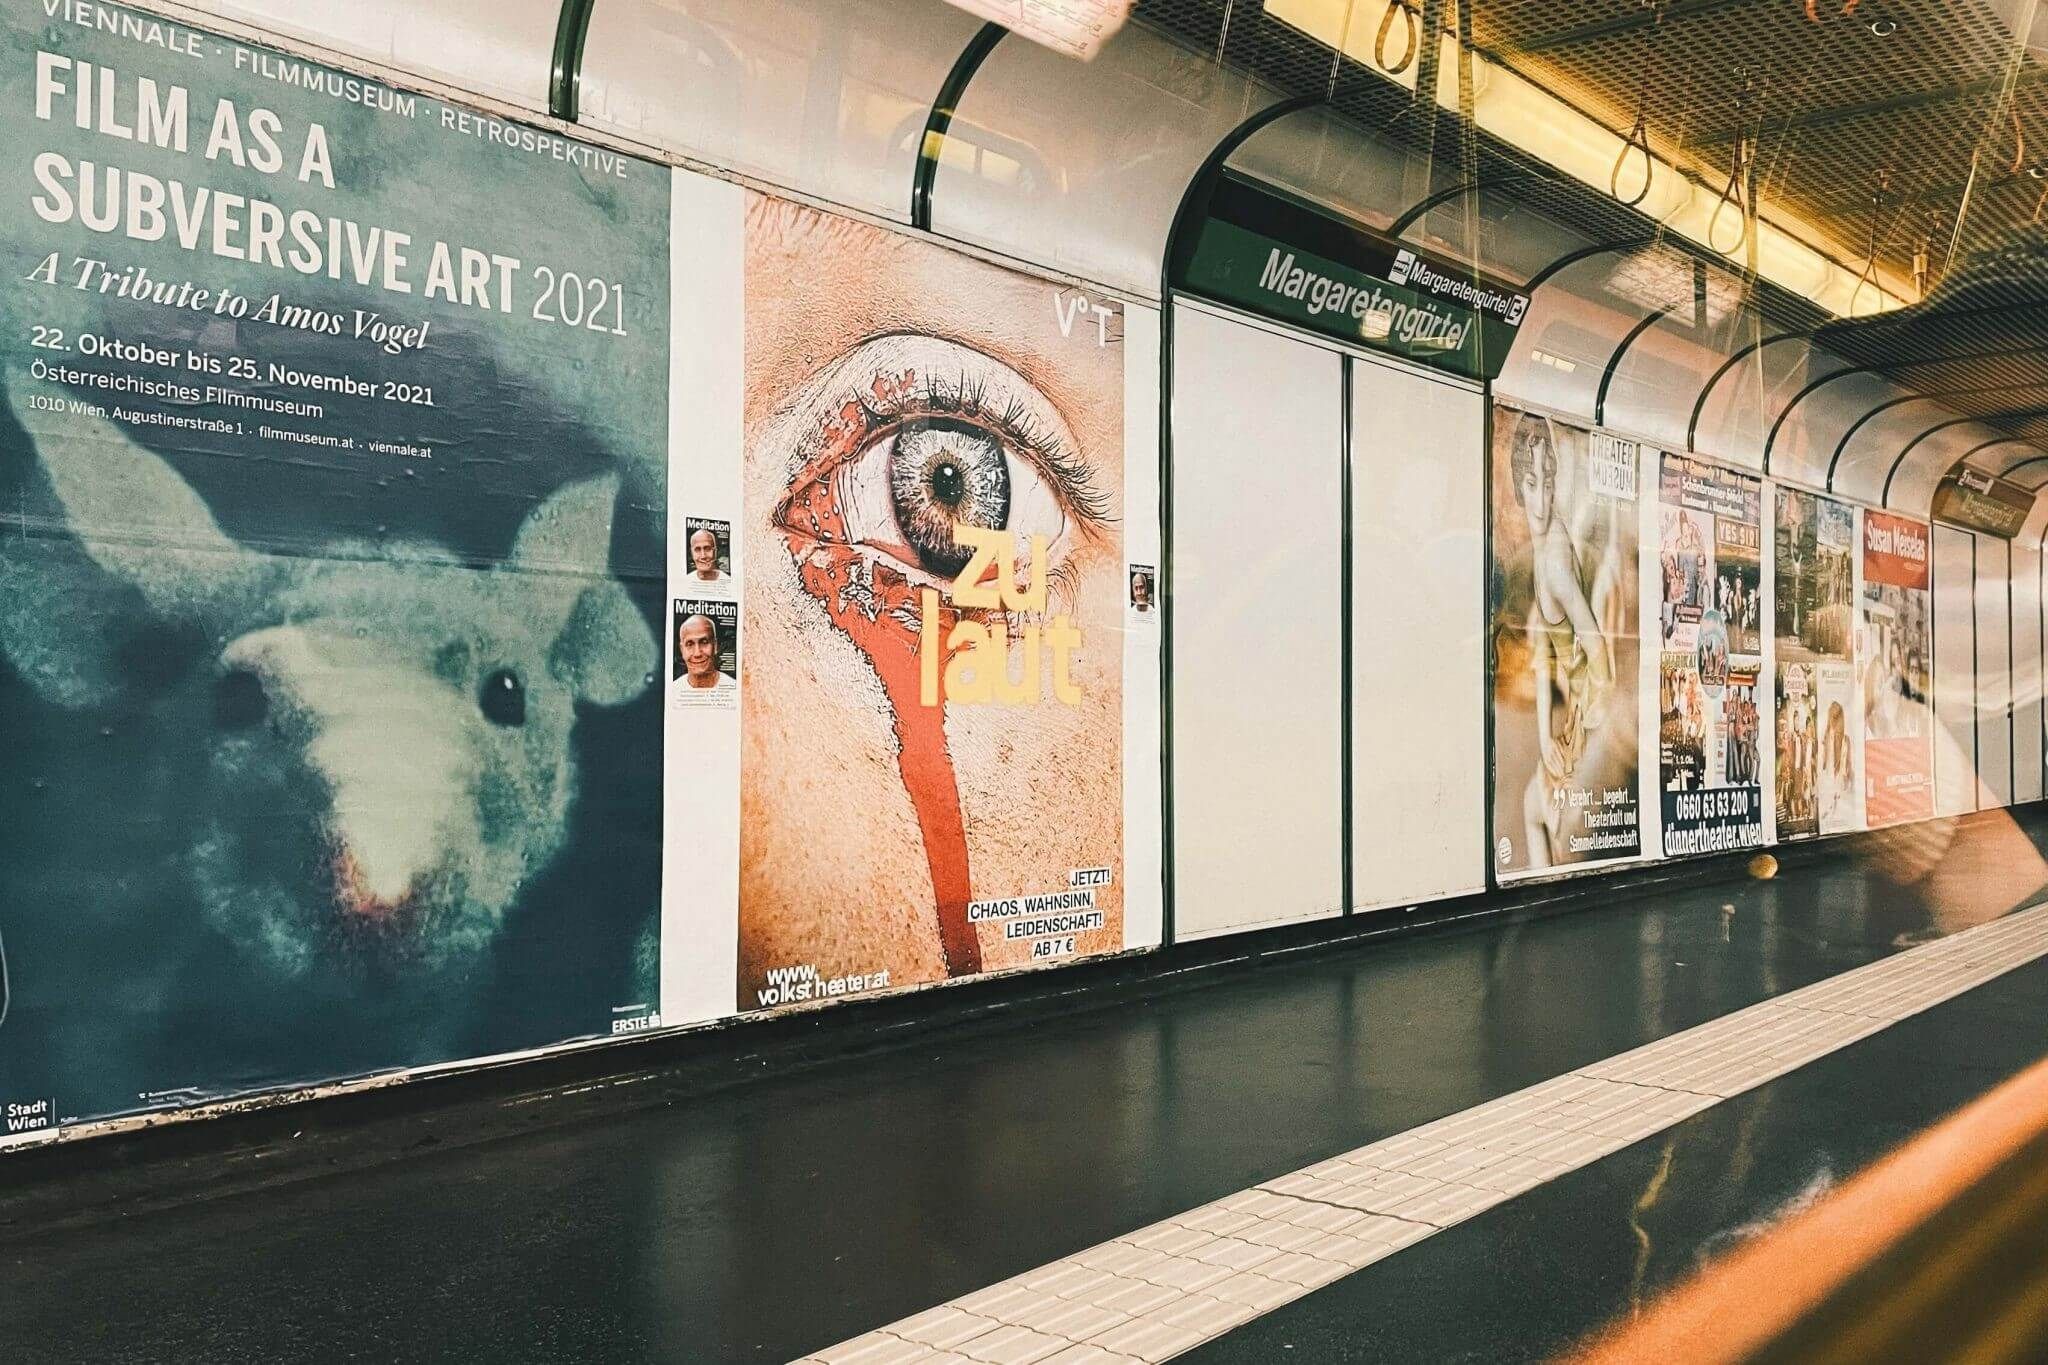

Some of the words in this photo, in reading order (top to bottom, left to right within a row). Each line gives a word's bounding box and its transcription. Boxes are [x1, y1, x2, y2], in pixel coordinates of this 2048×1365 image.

[42, 0, 205, 58] VIENNALE
[234, 46, 416, 119] FILMMUSEUM
[440, 107, 628, 179] RETROSPEKTIVE
[35, 50, 188, 152] FILM
[205, 97, 284, 174] AS
[297, 122, 336, 190] A
[31, 151, 412, 294] SUBVERSIVE
[424, 240, 521, 314] ART
[532, 266, 628, 337] 2021
[26, 252, 59, 284] A
[72, 257, 210, 311] Tribute
[214, 288, 248, 318] to
[250, 293, 345, 335] Amos
[352, 309, 431, 354] Vogel
[1409, 261, 1513, 315] Margaretengürtel
[30, 325, 71, 352] 22.
[78, 333, 181, 368] Oktober
[187, 350, 222, 374] bis
[227, 356, 263, 381] 25.
[268, 363, 379, 398] November
[383, 381, 434, 406] 2021
[30, 358, 201, 401] Österreichisches
[206, 386, 323, 418] Filmmuseum
[29, 395, 65, 412] 1010
[69, 400, 109, 419] Wien,
[112, 406, 234, 434] Augustinerstraße
[236, 422, 243, 435] 1
[259, 425, 354, 449] filmmuseum.at
[369, 442, 432, 459] viennale.at
[687, 518, 730, 531] Meditation
[1867, 519, 1892, 554] Susan
[952, 525, 1048, 611] zu
[675, 600, 736, 616] Meditation
[920, 588, 1083, 708] laut
[1603, 787, 1629, 810] begehrt
[1676, 793, 1700, 820] 0660
[1703, 792, 1715, 819] 63
[1717, 791, 1729, 817] 63
[1731, 790, 1748, 816] 200
[1583, 809, 1623, 829] Theaterkult
[1624, 808, 1637, 825] und
[1569, 828, 1638, 853] Sammelleidenschaft
[1664, 815, 1762, 857] dinnertheater.wien
[1071, 869, 1110, 886] JETZT!
[970, 900, 1022, 921] CHAOS,
[1025, 892, 1094, 914] WAHNSINN,
[1007, 912, 1102, 940] LEIDENSCHAFT!
[1033, 942, 1051, 958] AB
[1054, 940, 1061, 955] 7
[1065, 937, 1074, 953] €
[612, 1016, 649, 1033] ERSTE
[8, 1099, 47, 1117] Stadt
[8, 1116, 47, 1131] Wien
